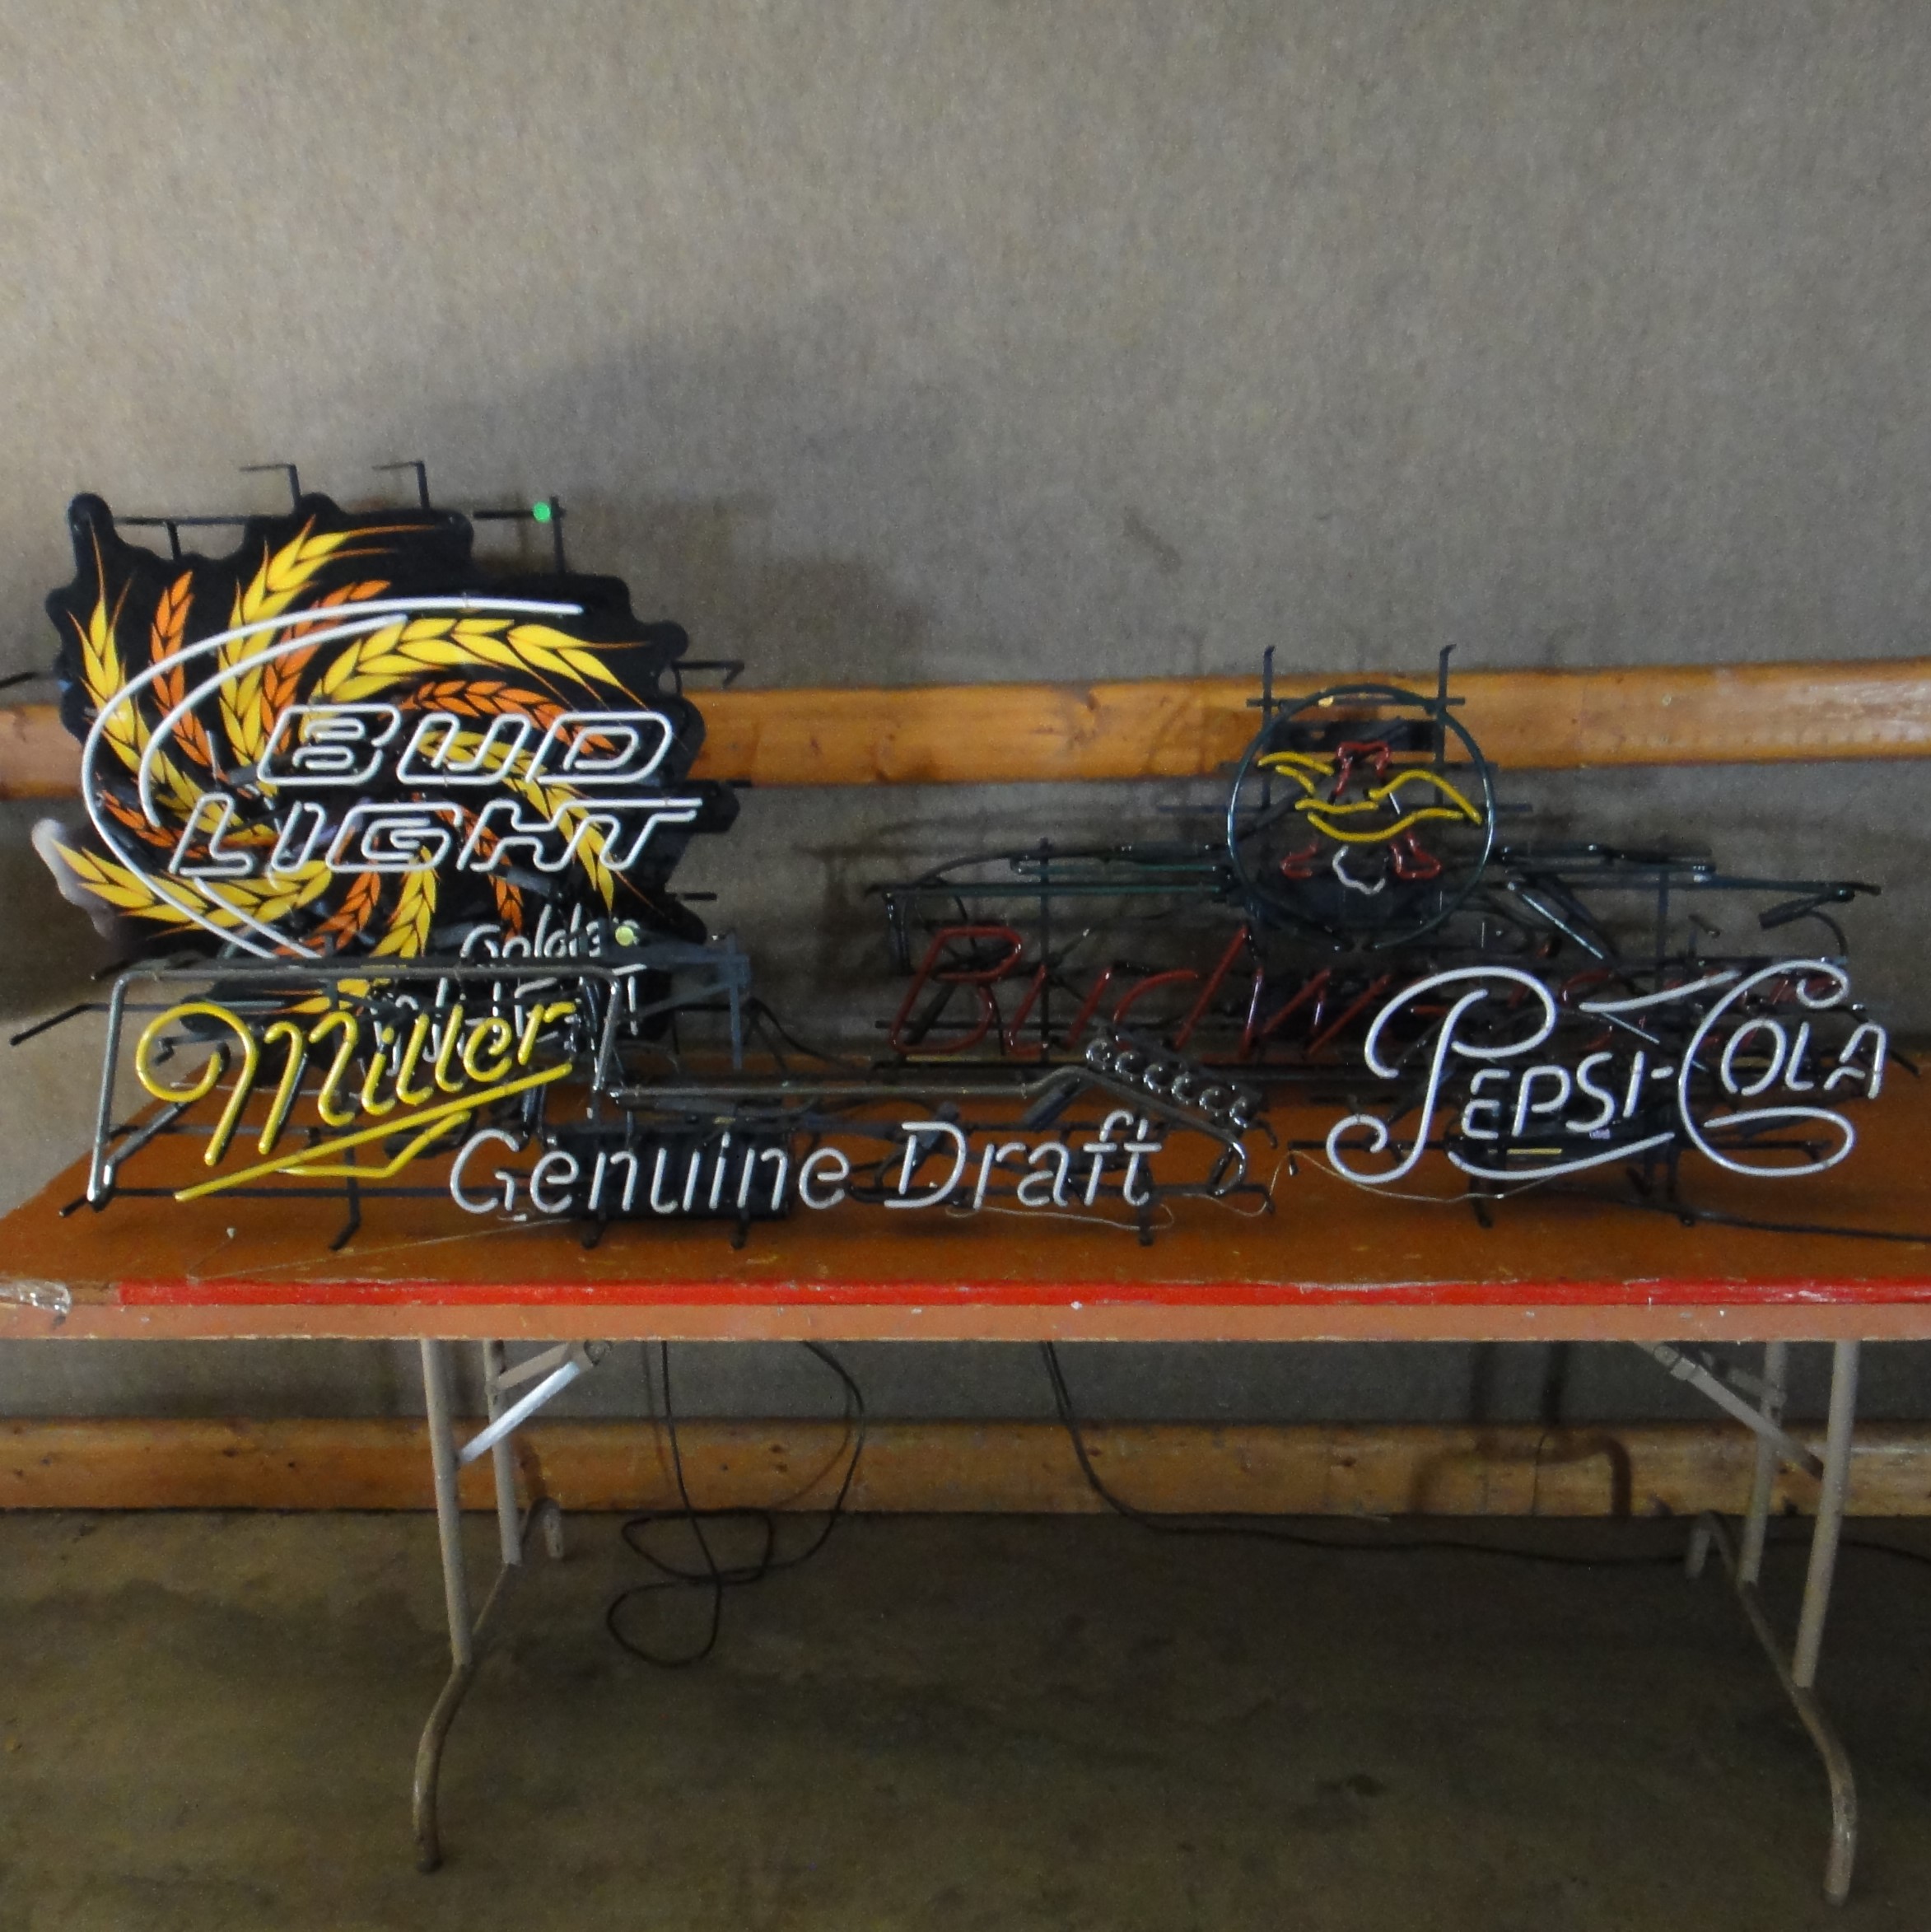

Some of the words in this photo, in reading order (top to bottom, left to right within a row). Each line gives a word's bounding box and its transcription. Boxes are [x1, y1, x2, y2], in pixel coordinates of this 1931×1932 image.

[255, 702, 673, 785] BUD
[168, 791, 703, 876] LIGHT
[135, 1001, 576, 1166] Miller
[450, 1129, 850, 1214] Genuine
[884, 1109, 1163, 1211] Draft
